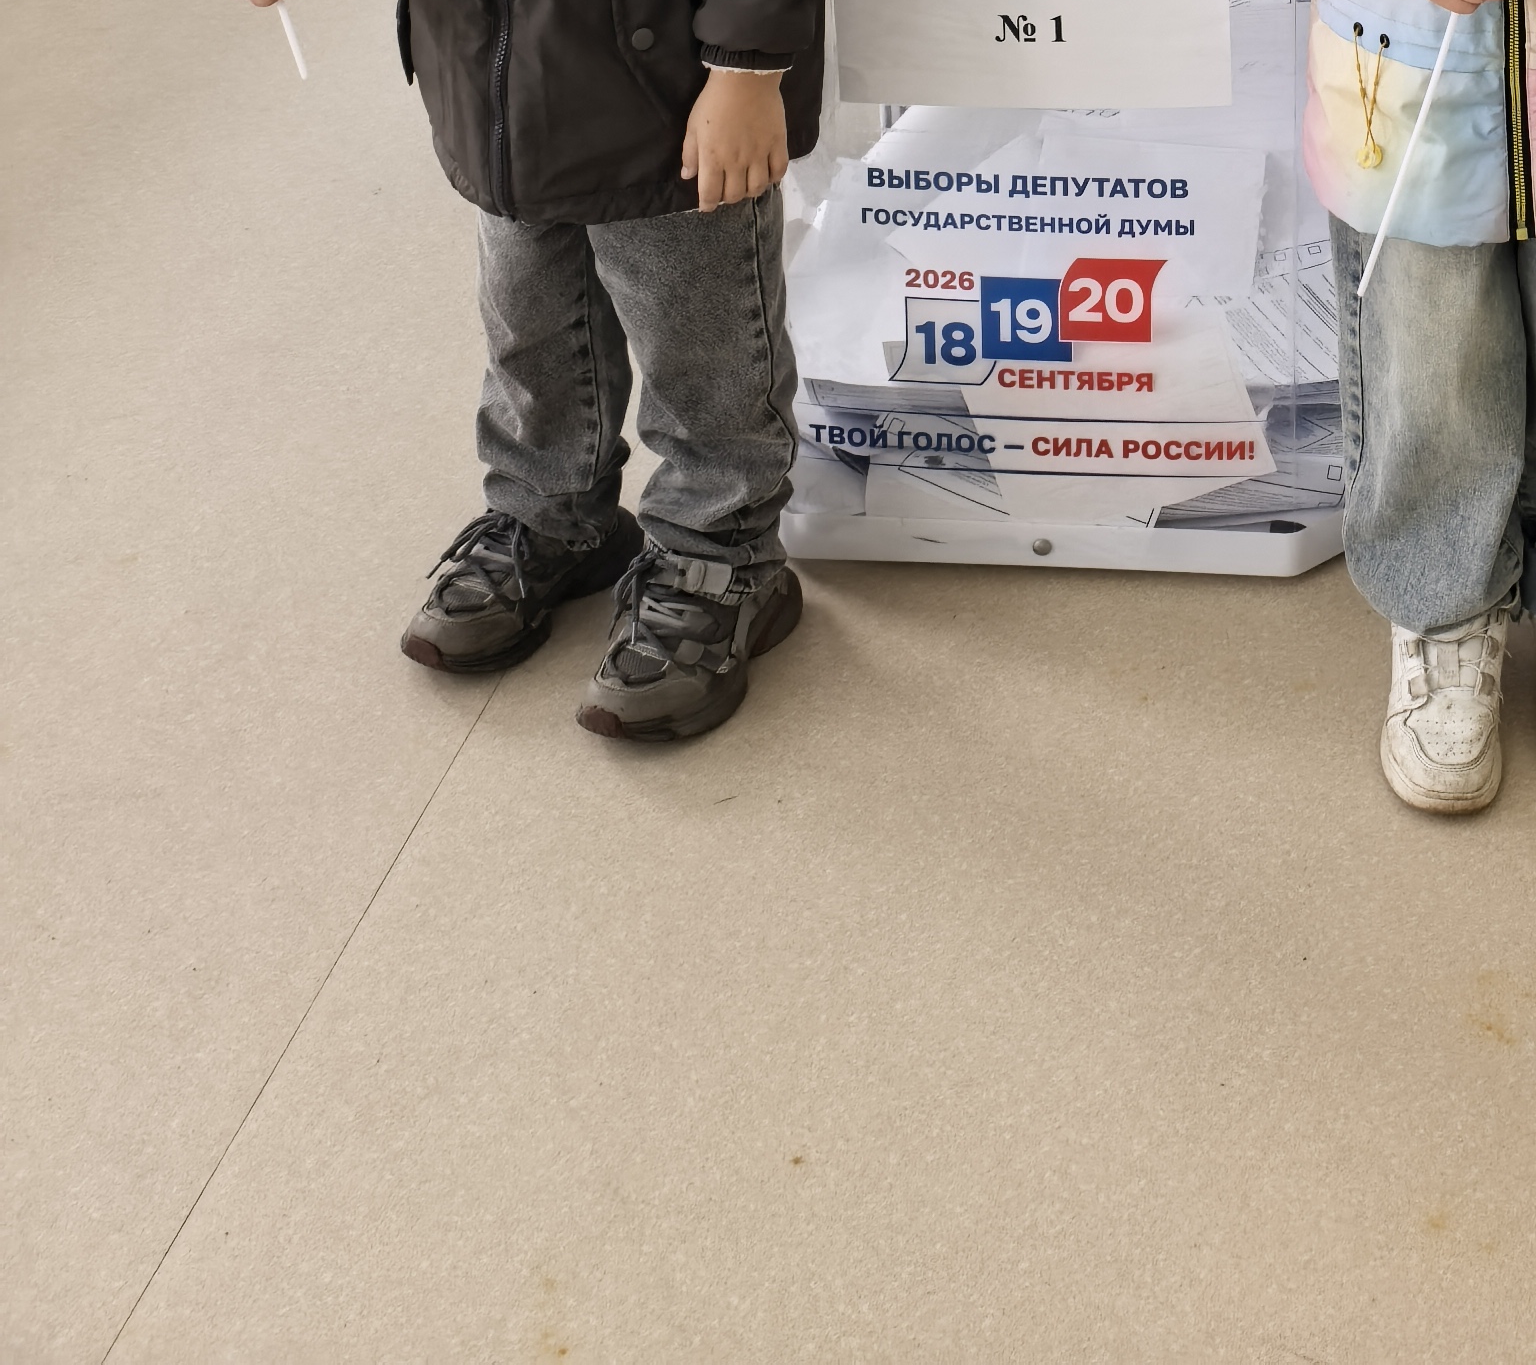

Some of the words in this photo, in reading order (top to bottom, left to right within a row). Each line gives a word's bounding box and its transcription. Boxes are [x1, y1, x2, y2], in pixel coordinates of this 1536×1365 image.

[995, 13, 1038, 44] №
[1050, 14, 1067, 44] 1
[866, 166, 1001, 195] ВЫБОРЫ
[1008, 170, 1189, 201] ДЕПУТАТОВ
[860, 206, 1113, 236] ГОСУДАРСТВЕННОЙ
[1117, 215, 1196, 239] ДУМЫ
[904, 268, 975, 293] 2026
[915, 320, 978, 368] 18
[989, 298, 1053, 344] 19
[1068, 276, 1146, 324] 20
[997, 367, 1155, 394] СЕНТЯБРЯ
[808, 421, 890, 449] ТВОЙ
[897, 429, 996, 455] ГОЛОС
[1030, 435, 1114, 460] СИЛА
[1121, 437, 1256, 461] РОССИИ!
